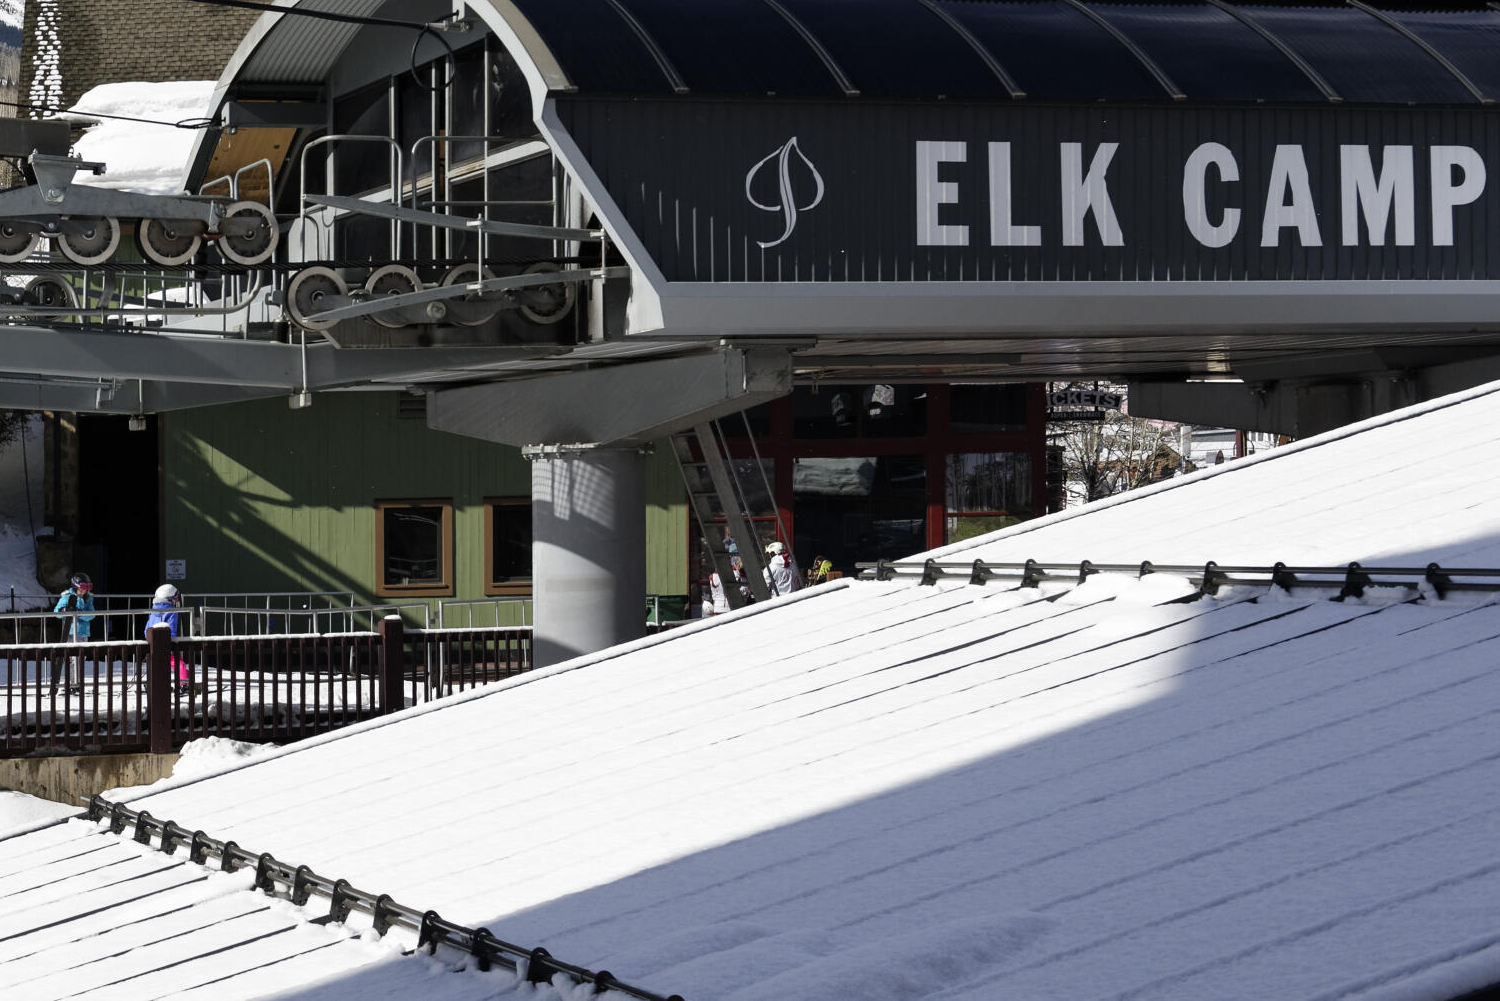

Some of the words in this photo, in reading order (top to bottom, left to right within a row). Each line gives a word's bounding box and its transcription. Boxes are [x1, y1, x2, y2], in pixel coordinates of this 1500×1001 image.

[916, 140, 1125, 247] ELK
[1182, 141, 1487, 248] CAMP
[1046, 391, 1117, 408] ICKETS
